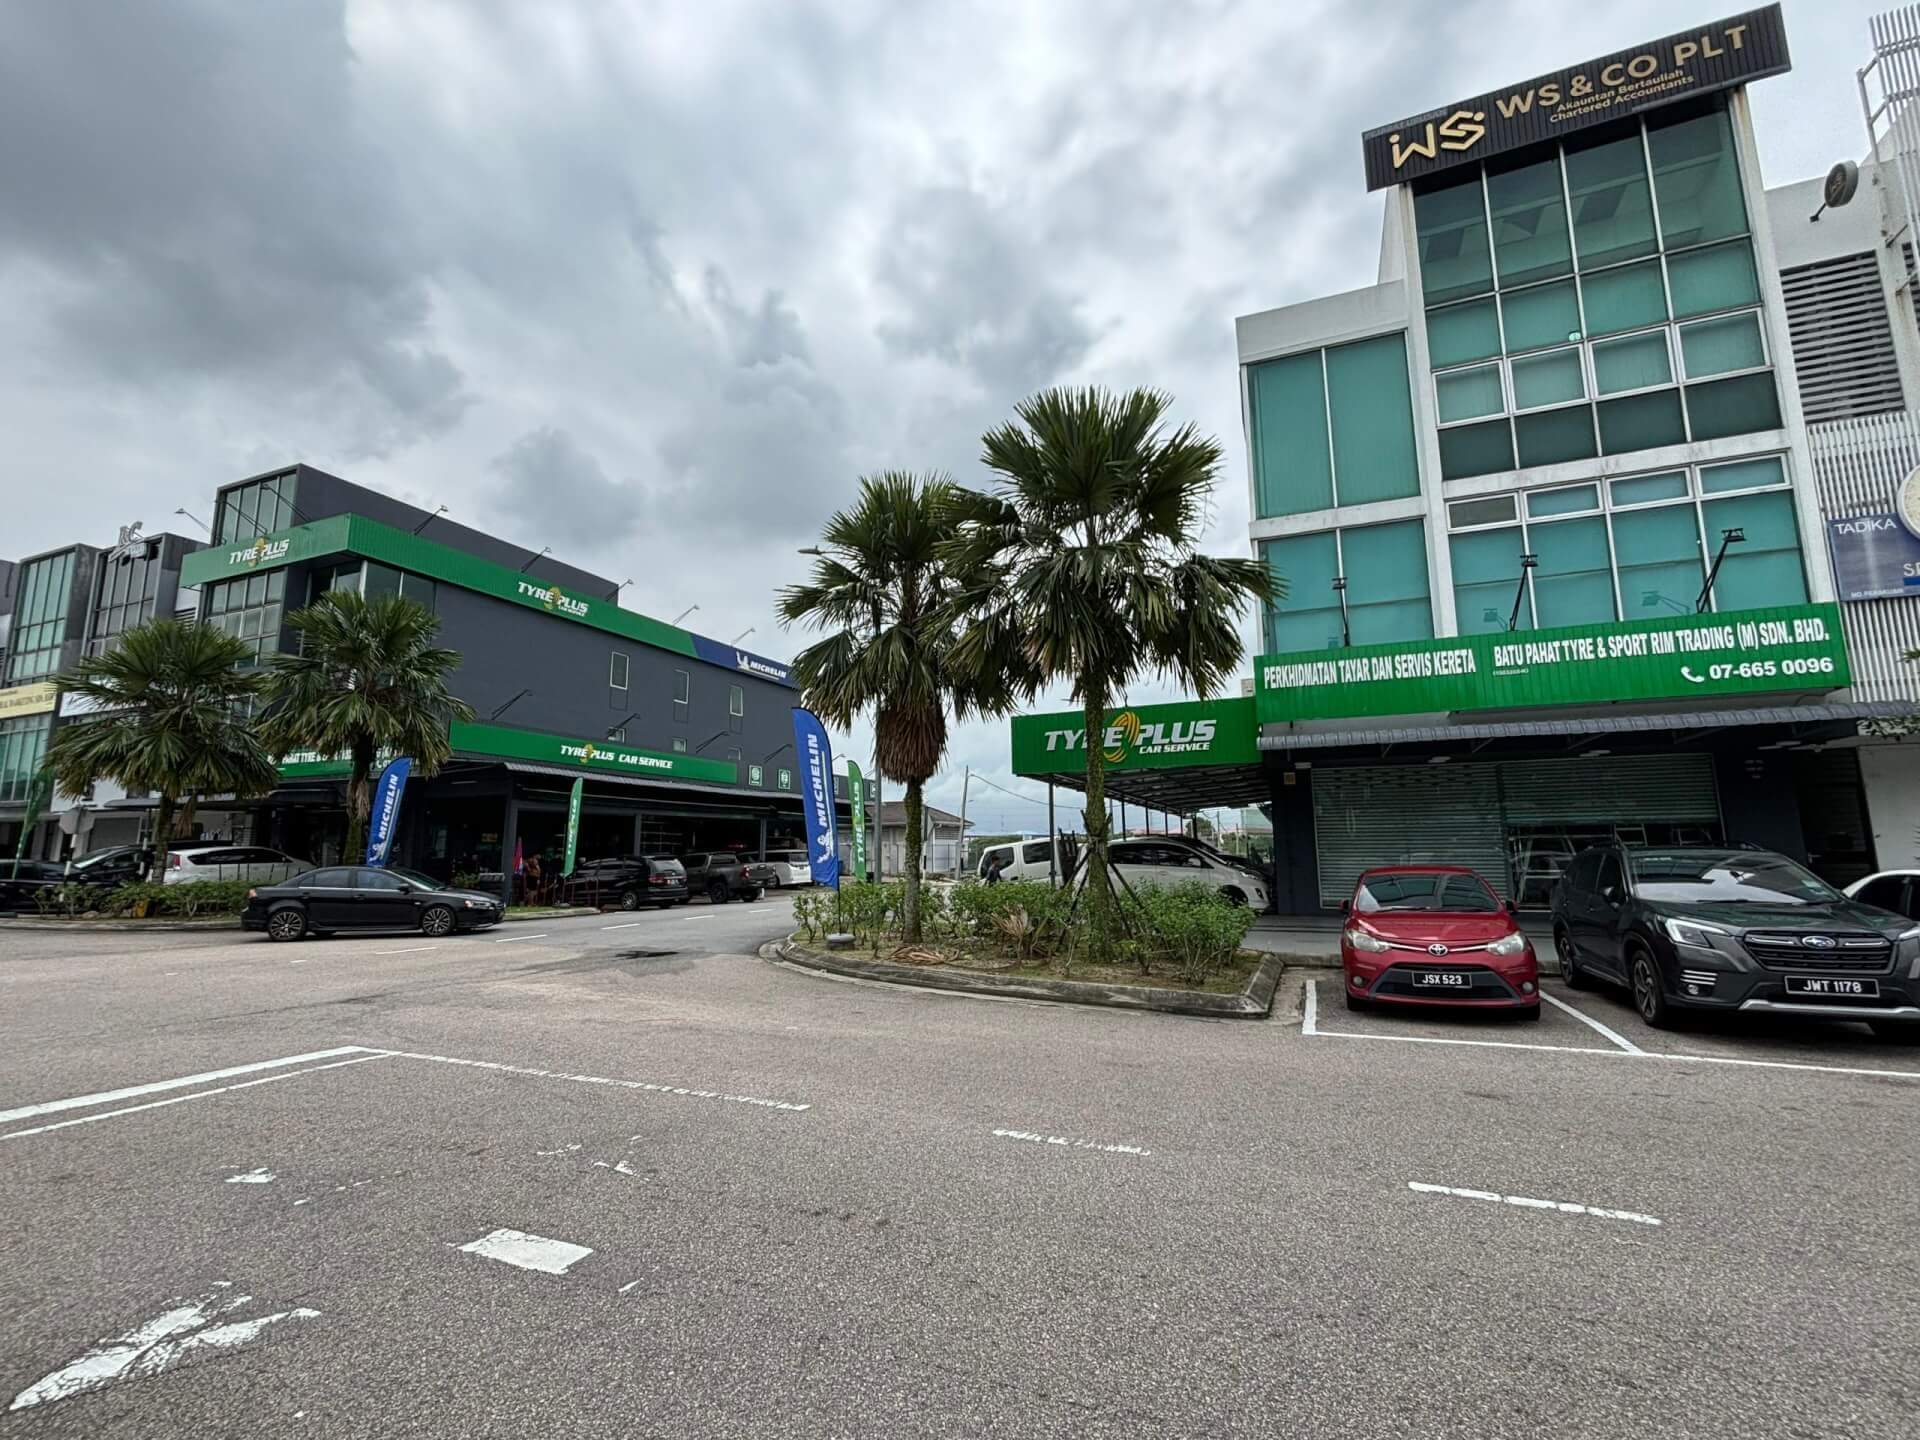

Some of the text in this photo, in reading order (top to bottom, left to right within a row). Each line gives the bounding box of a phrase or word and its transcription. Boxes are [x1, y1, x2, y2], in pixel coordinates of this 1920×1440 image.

[1496, 25, 1746, 119] WS & CO PLT
[1550, 75, 1694, 123] Chartered Accountants
[1557, 91, 1615, 113] Akauntan
[1834, 518, 1898, 535] TADIKA
[229, 546, 258, 565] TYRE
[260, 538, 290, 557] PLUS
[518, 581, 589, 613] TYRE PLUS
[1493, 618, 1830, 668] BATU PAHAT TYRE & SPORT RIM TRADING (M) SDN. BHD.
[750, 660, 787, 679] MICHELIN
[1263, 648, 1477, 690] PERKHIDMATAN TAYAR DAN SERVIS KERETA
[1709, 657, 1834, 680] 07-665 0096
[1135, 719, 1217, 746] PLUS
[560, 745, 673, 769] TYRE PLUS CAR SERVICE
[1139, 742, 1210, 754] CAR SERVICE
[807, 733, 828, 828] MICHELIN
[378, 773, 399, 840] MICHELIN
[1422, 974, 1463, 985] JSX 523
[1803, 979, 1862, 993] JWT 1178
